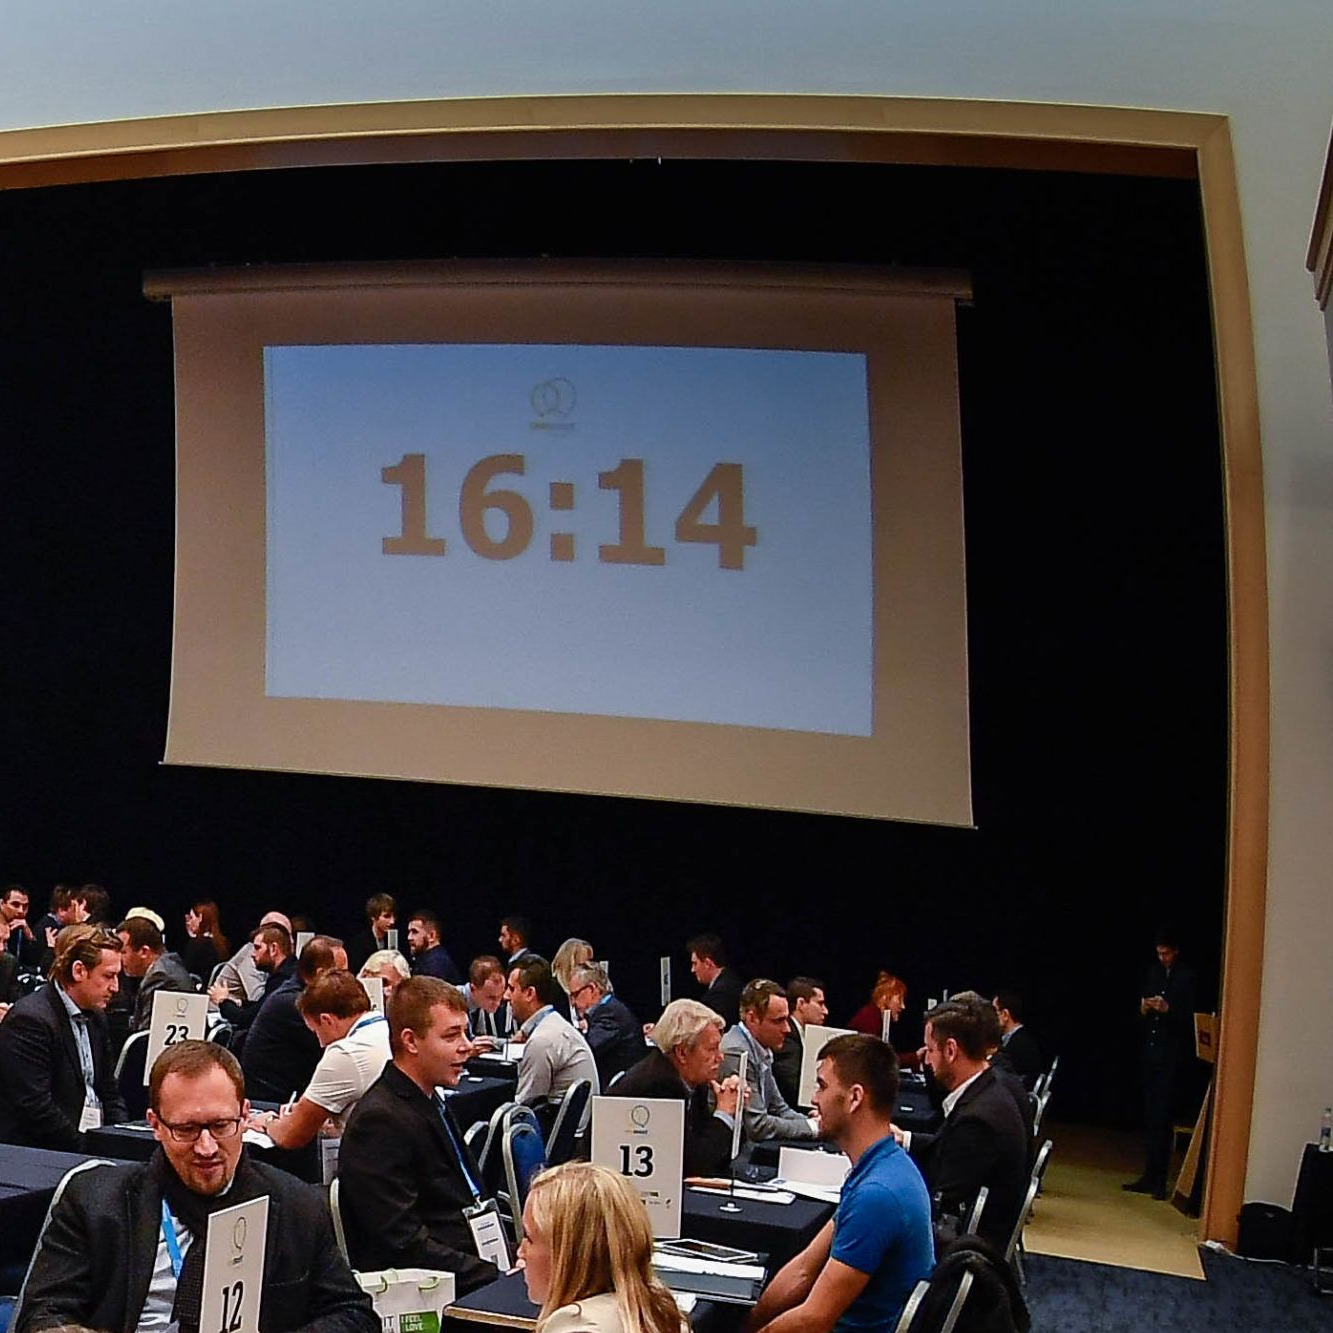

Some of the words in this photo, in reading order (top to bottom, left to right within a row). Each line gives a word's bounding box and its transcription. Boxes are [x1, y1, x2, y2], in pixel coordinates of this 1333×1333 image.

[381, 453, 757, 570] 16:14
[164, 1024, 190, 1046] 23
[619, 1145, 654, 1178] 13
